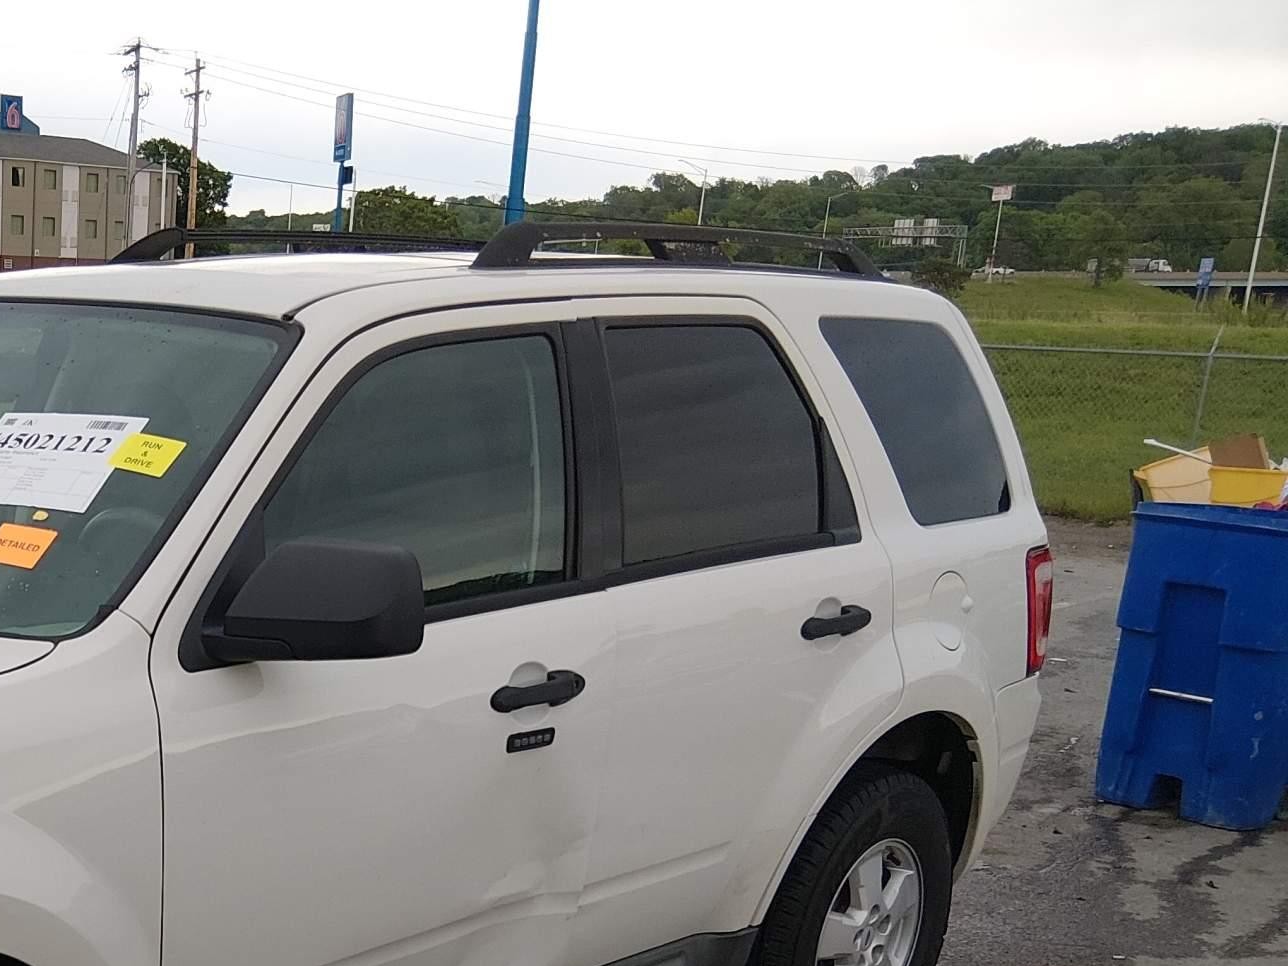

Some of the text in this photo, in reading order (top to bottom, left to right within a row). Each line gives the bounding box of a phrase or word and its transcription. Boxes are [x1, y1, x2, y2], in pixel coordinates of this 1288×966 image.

[6, 101, 20, 129] 6
[140, 440, 164, 451] RUN
[140, 450, 148, 458] &
[123, 456, 154, 469] DRIVE
